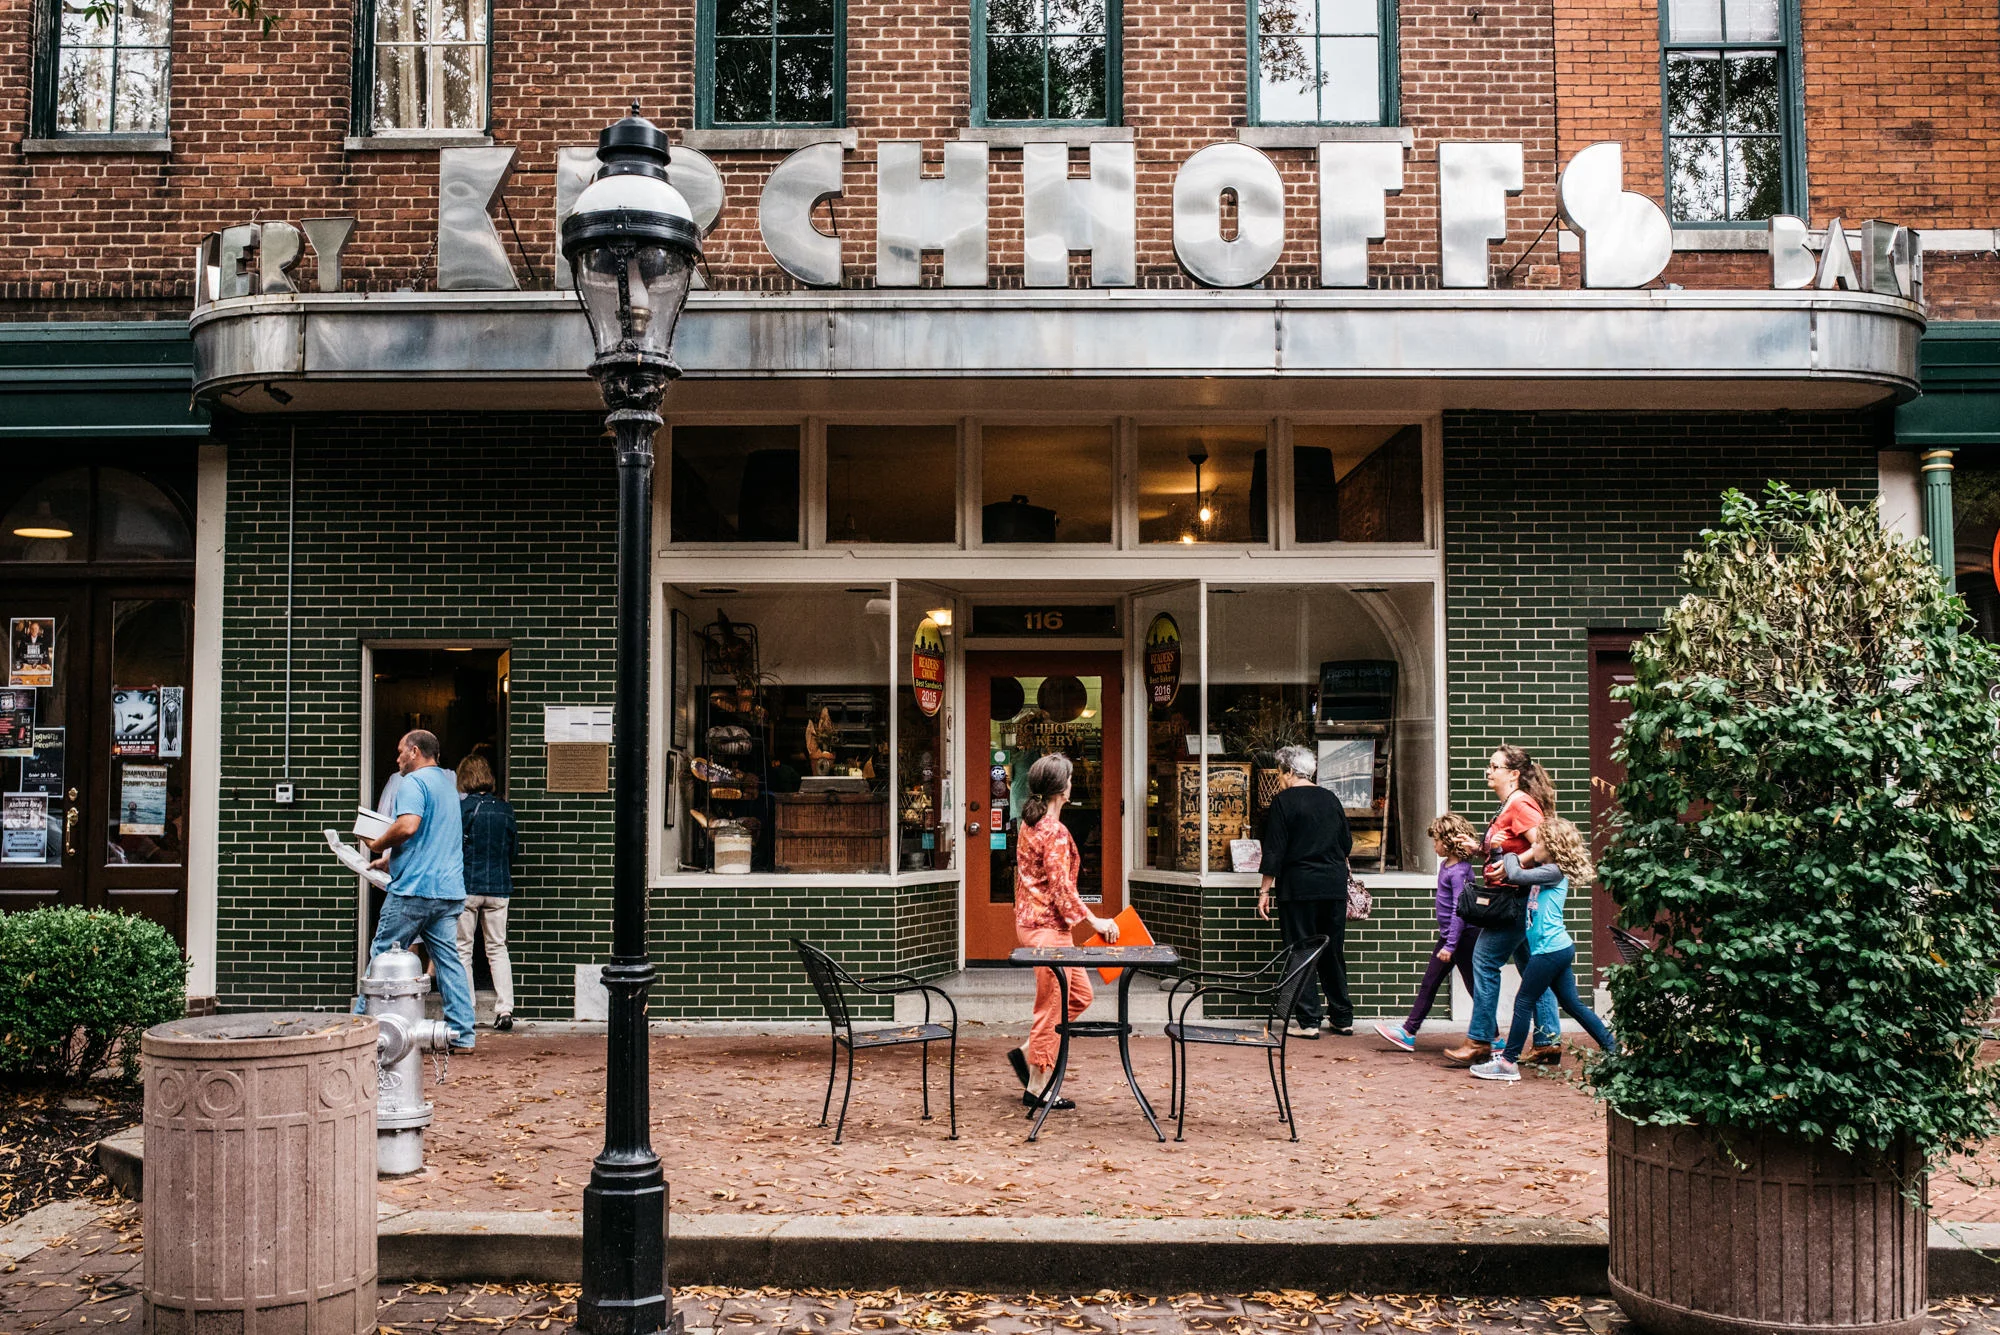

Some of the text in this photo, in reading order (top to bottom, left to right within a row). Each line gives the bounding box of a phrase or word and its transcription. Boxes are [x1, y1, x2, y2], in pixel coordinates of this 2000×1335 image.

[1024, 611, 1064, 630] 116
[921, 668, 937, 680] CHOICE
[1160, 675, 1176, 683] Bakery
[915, 679, 943, 690] Best Sandwich
[1154, 685, 1171, 696] 2016
[921, 691, 937, 702] 2015
[1154, 694, 1171, 702] WINNER
[999, 722, 1094, 735] KIRCHHOFF'S
